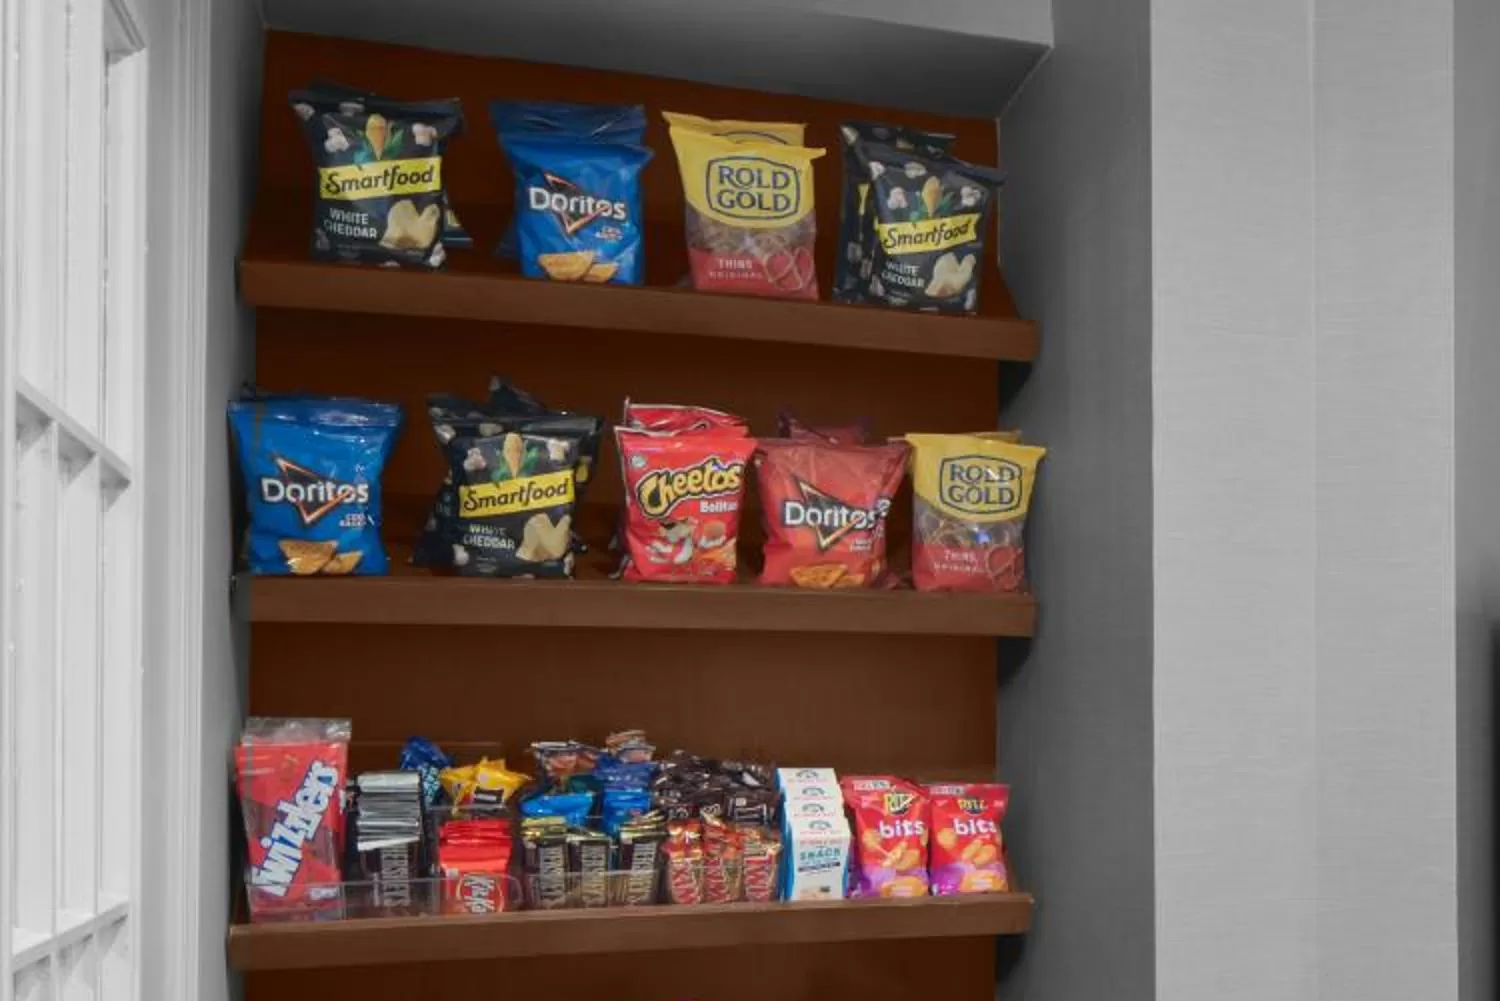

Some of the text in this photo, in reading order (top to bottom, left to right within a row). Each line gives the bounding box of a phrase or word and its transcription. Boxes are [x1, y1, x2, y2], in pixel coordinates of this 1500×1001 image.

[324, 162, 435, 195] Smartfood
[718, 165, 791, 190] ROLD
[529, 186, 627, 220] Doritos
[717, 188, 791, 212] GOLD
[323, 219, 378, 239] CHEDDAR
[329, 208, 369, 225] WHITE
[883, 221, 971, 249] Smartfood
[949, 463, 1015, 484] ROLD
[262, 477, 369, 504] Doritos
[463, 478, 569, 511] Smartfood
[637, 458, 741, 517] Cheetos
[948, 484, 1014, 506] GOLD
[785, 501, 877, 529] Doritos
[880, 820, 924, 838] bits
